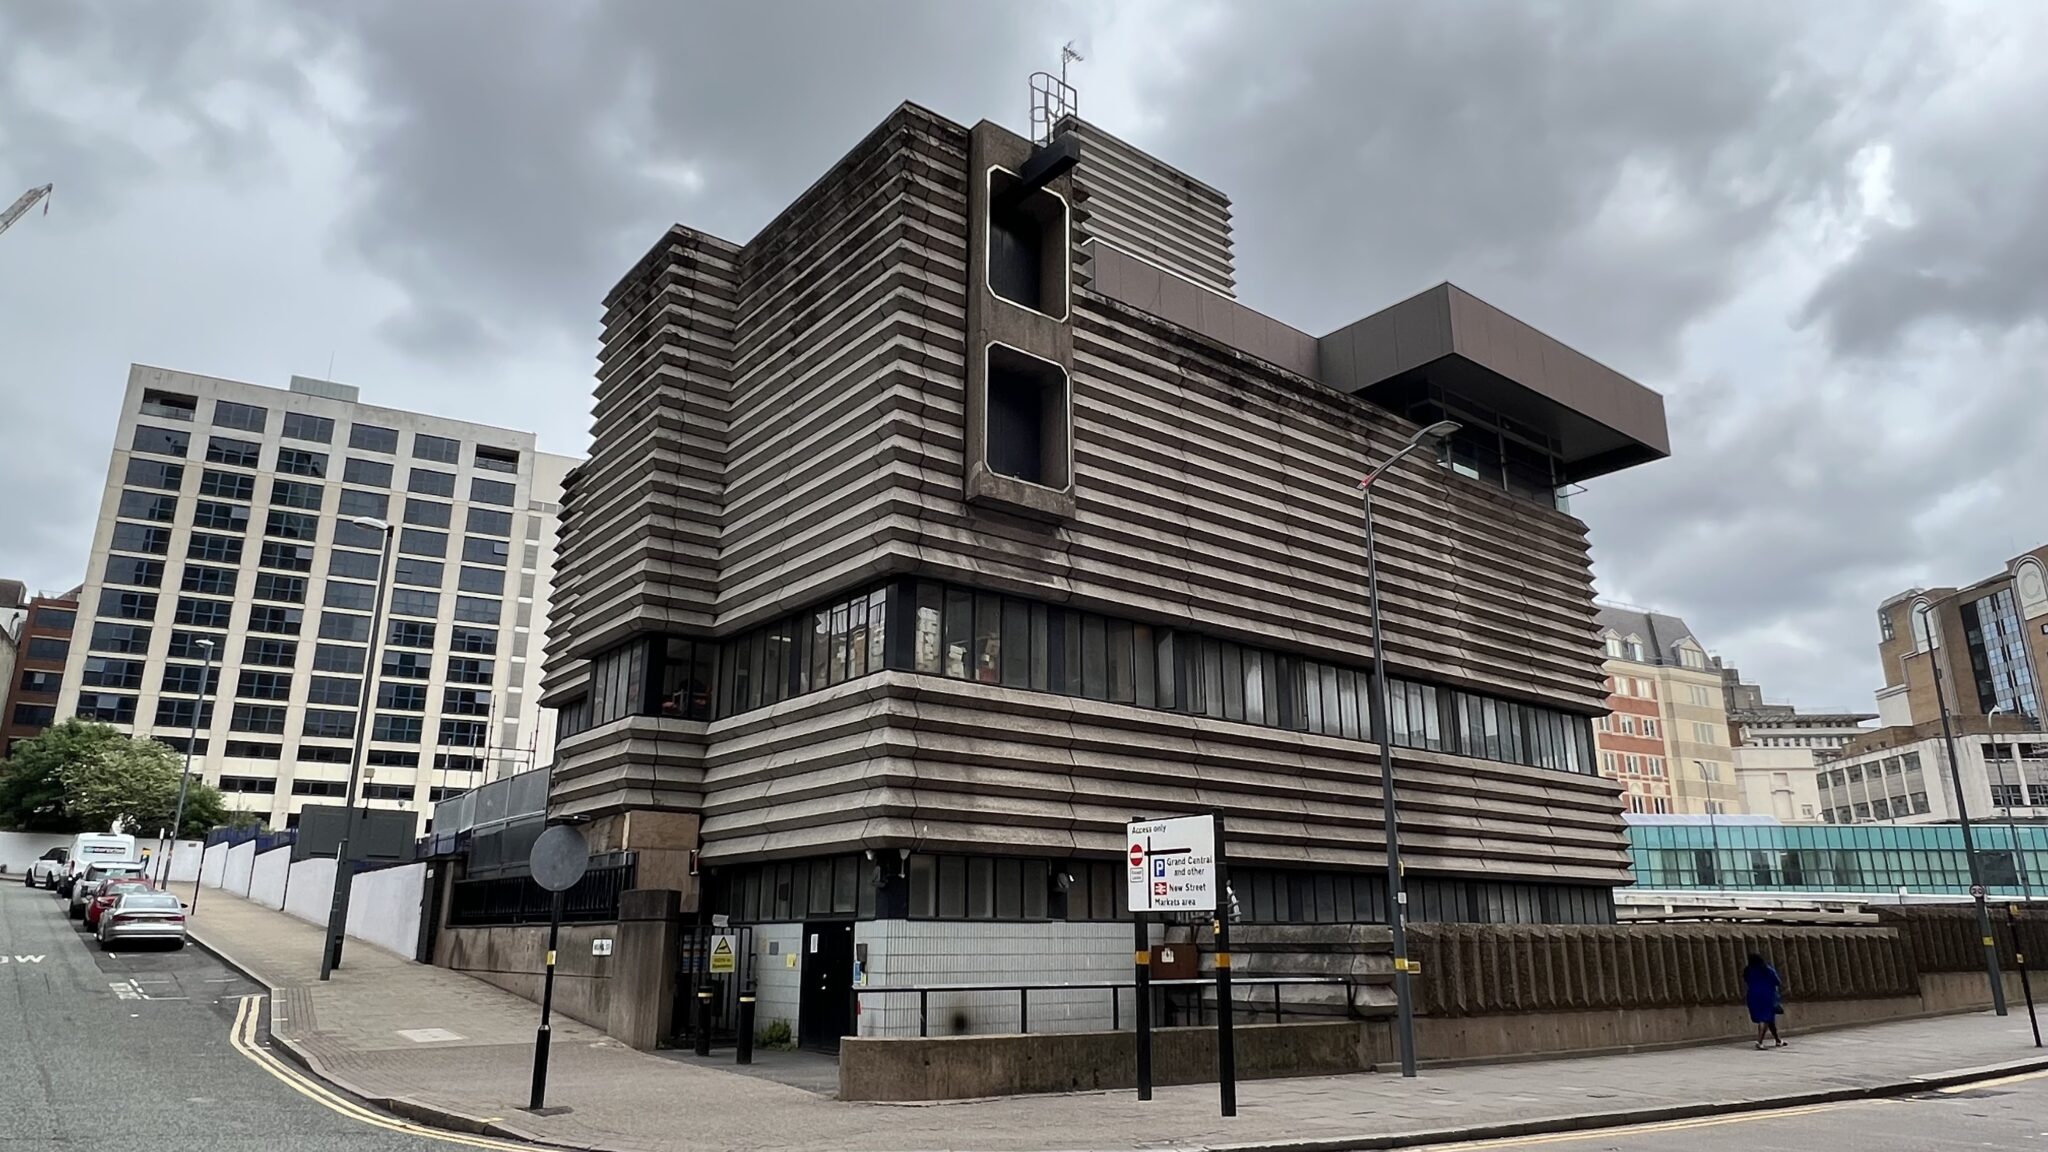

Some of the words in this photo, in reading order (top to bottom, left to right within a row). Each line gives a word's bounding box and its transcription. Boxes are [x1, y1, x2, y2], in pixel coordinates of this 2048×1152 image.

[1132, 826, 1152, 834] Access
[1153, 824, 1167, 833] only
[1166, 857, 1186, 866] Grand
[1187, 855, 1213, 865] Central
[1174, 868, 1186, 876] and
[1187, 867, 1205, 876] other
[1169, 884, 1183, 892] New
[1185, 882, 1206, 891] Street
[1154, 898, 1180, 906] Markets
[1181, 898, 1196, 906] area
